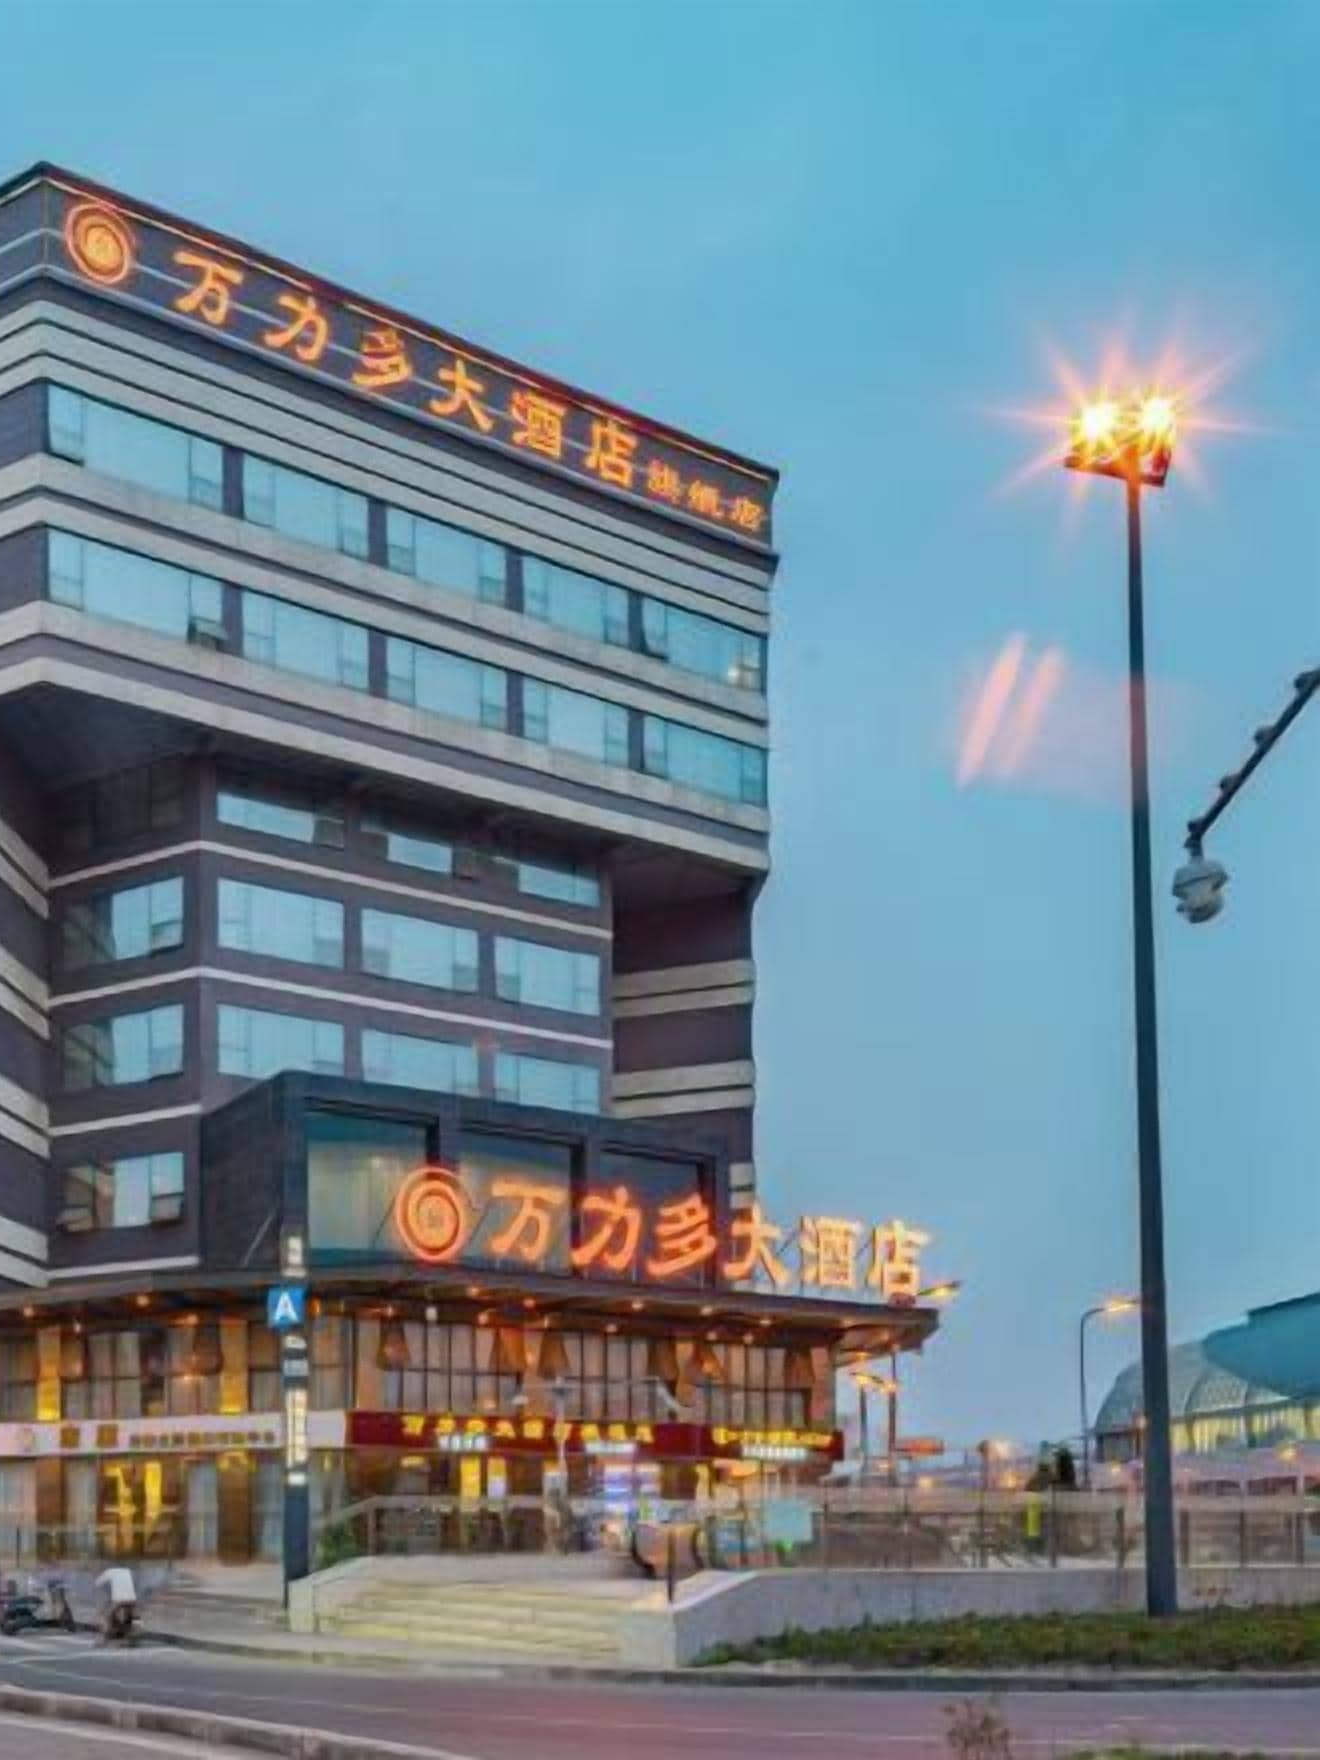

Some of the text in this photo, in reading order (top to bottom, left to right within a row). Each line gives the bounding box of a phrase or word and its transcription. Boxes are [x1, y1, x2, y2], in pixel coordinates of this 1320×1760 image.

[173, 250, 638, 489] 万力多大酒店
[491, 1181, 928, 1298] 万力多大酒店
